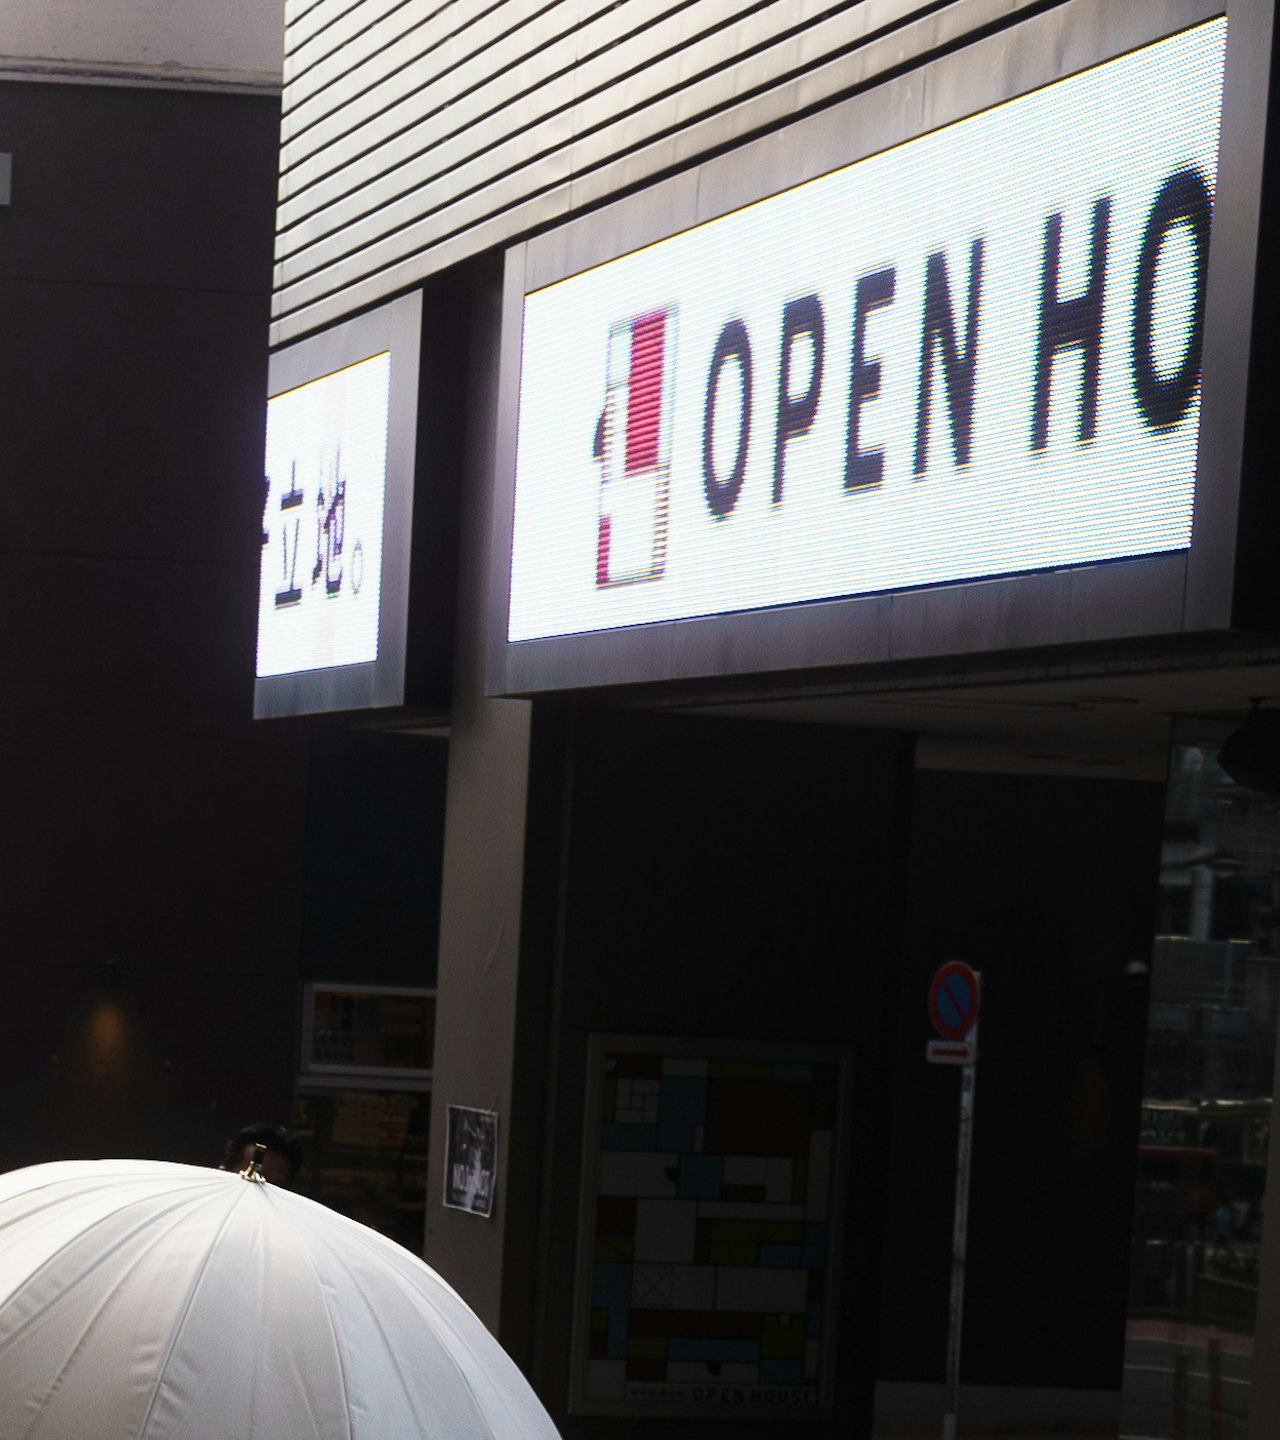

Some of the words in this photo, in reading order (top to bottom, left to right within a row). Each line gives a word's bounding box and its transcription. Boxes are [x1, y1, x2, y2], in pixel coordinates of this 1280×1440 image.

[701, 233, 985, 520] OPEN
[691, 1387, 745, 1403] OPEN
[750, 1389, 813, 1405] HOUSE
